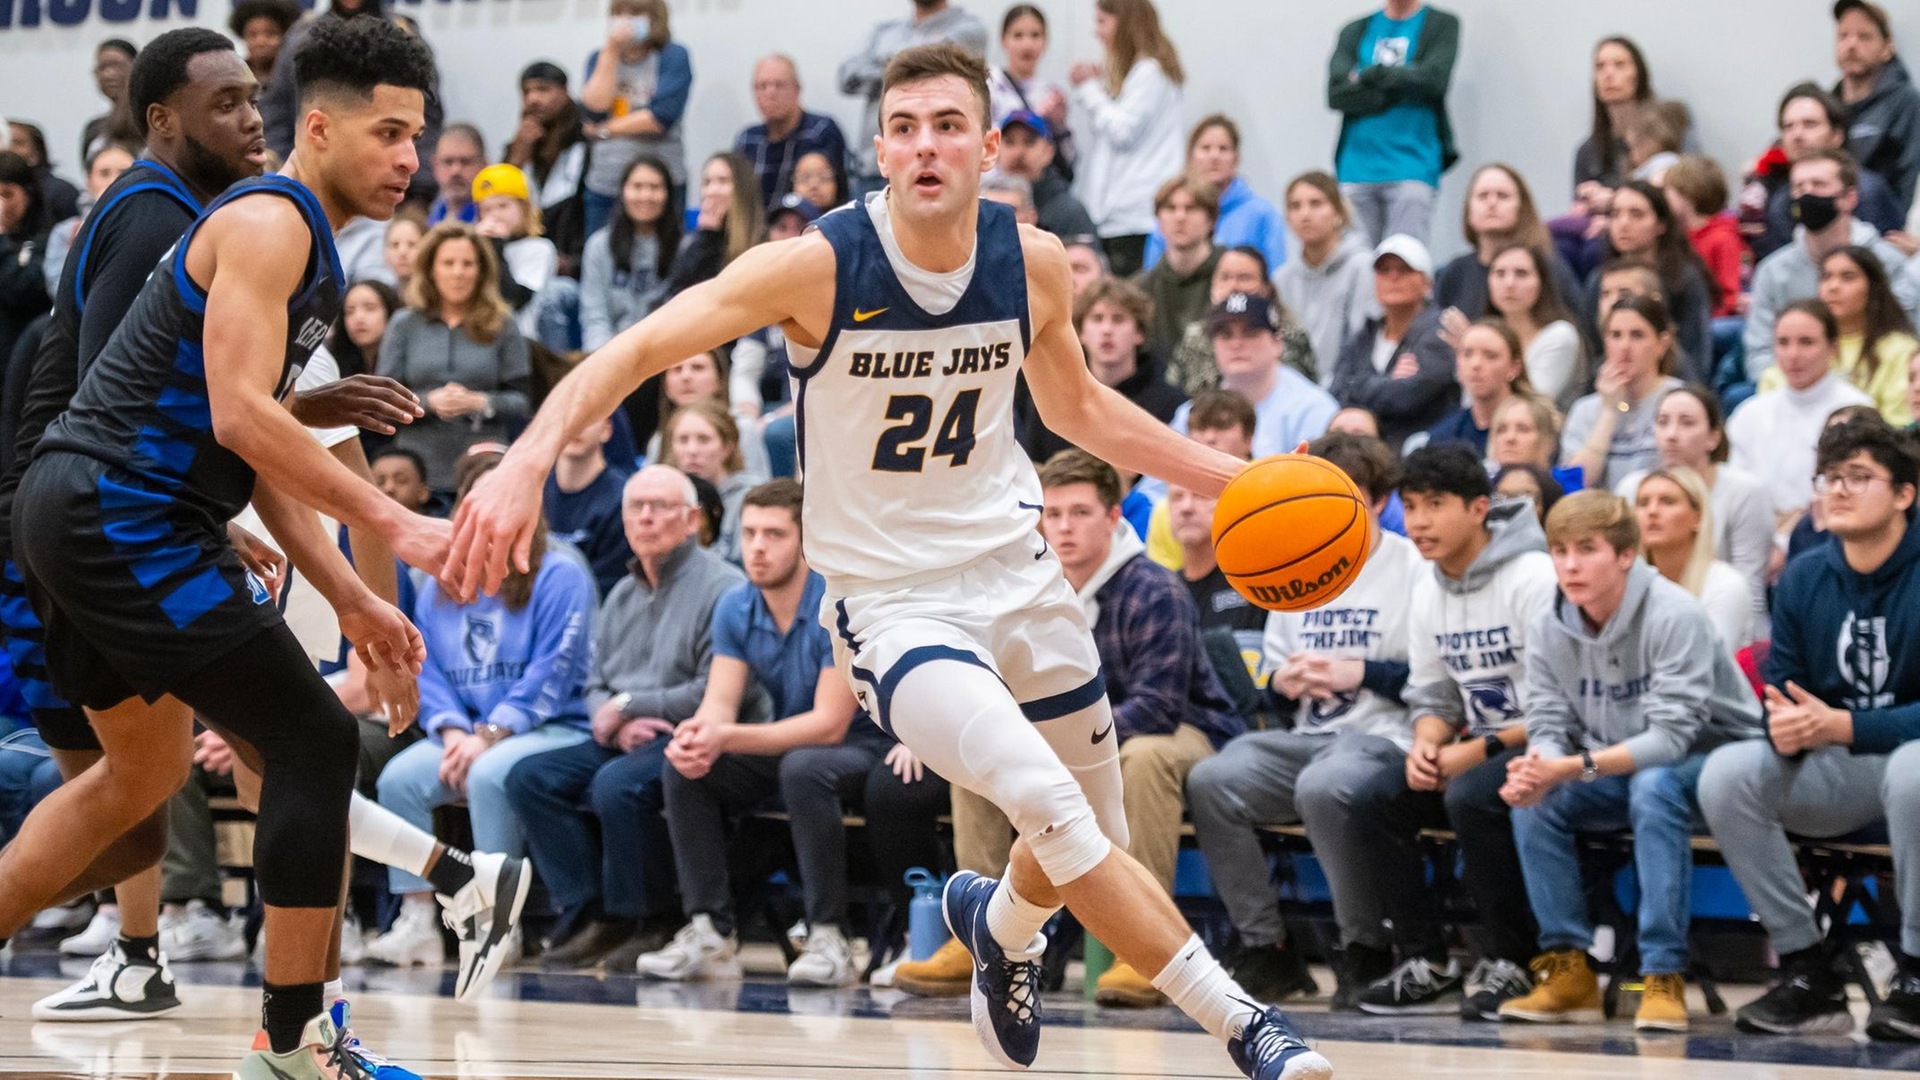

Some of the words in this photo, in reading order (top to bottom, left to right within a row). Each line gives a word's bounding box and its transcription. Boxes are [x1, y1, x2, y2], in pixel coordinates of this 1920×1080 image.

[849, 351, 935, 379] BLUE
[942, 341, 1012, 376] JAYS
[871, 388, 982, 473] 24
[1246, 556, 1350, 603] Wilson
[1435, 625, 1509, 649] OTECT
